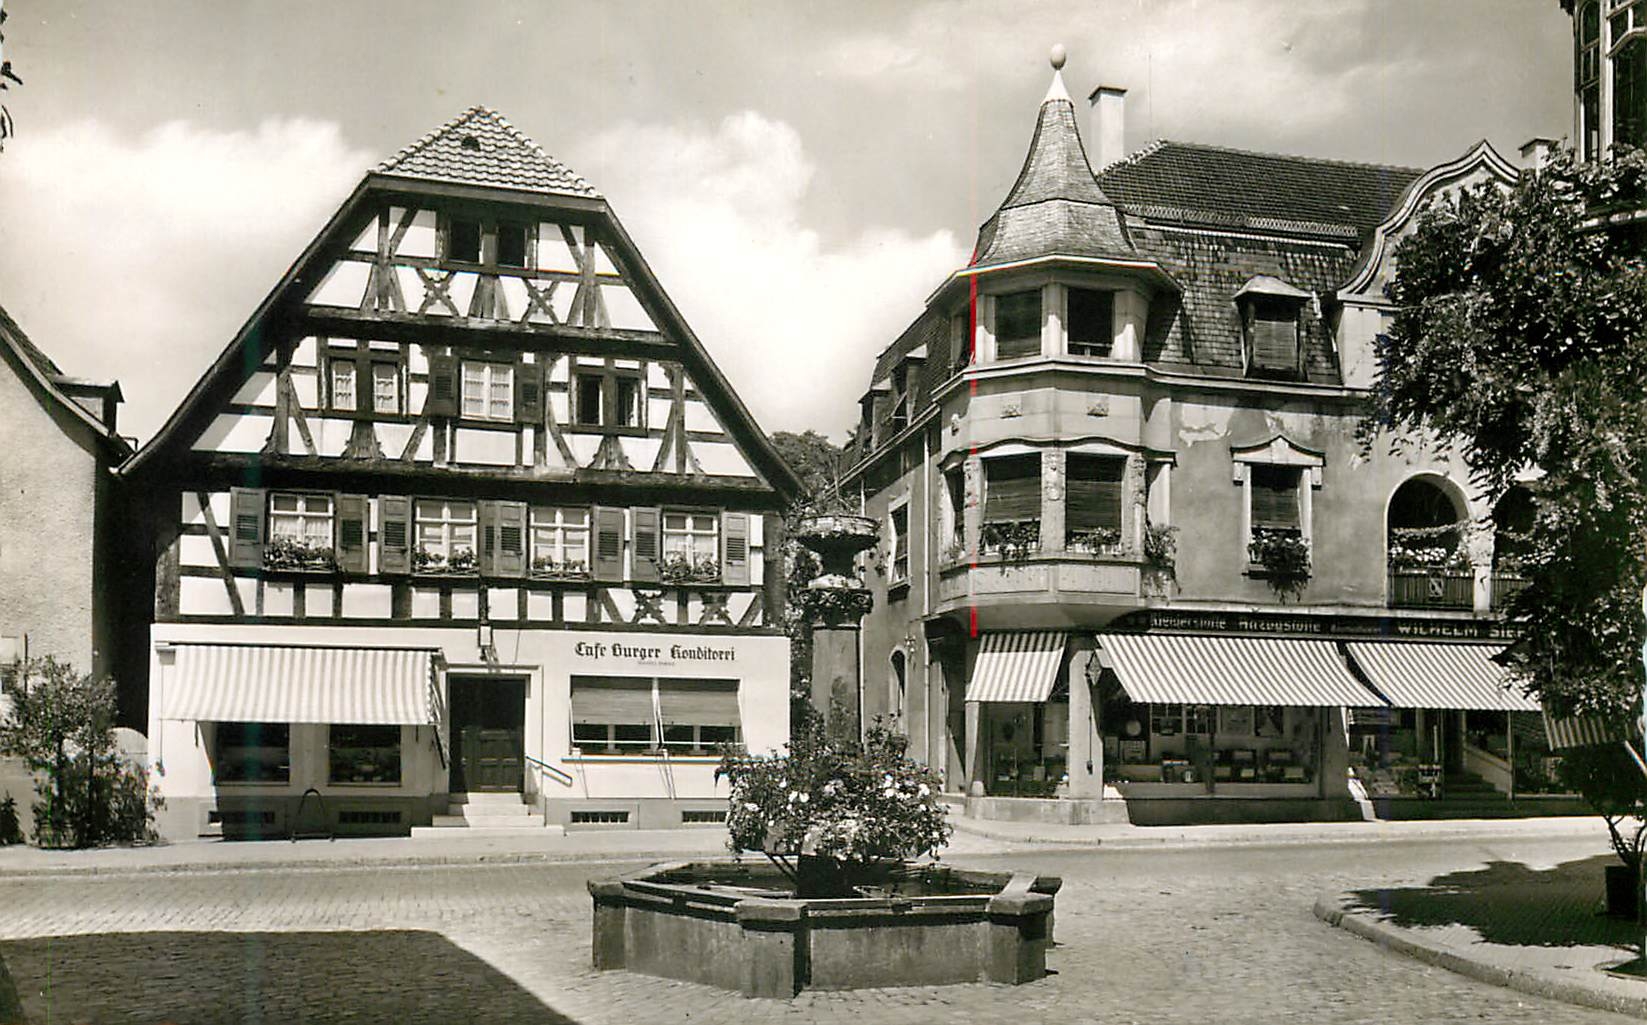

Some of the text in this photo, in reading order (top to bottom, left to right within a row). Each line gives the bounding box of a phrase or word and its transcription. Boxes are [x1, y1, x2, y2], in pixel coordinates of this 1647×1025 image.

[1398, 621, 1478, 637] WILHELM
[611, 642, 662, 661] Burger
[670, 644, 736, 662] Konditorei
